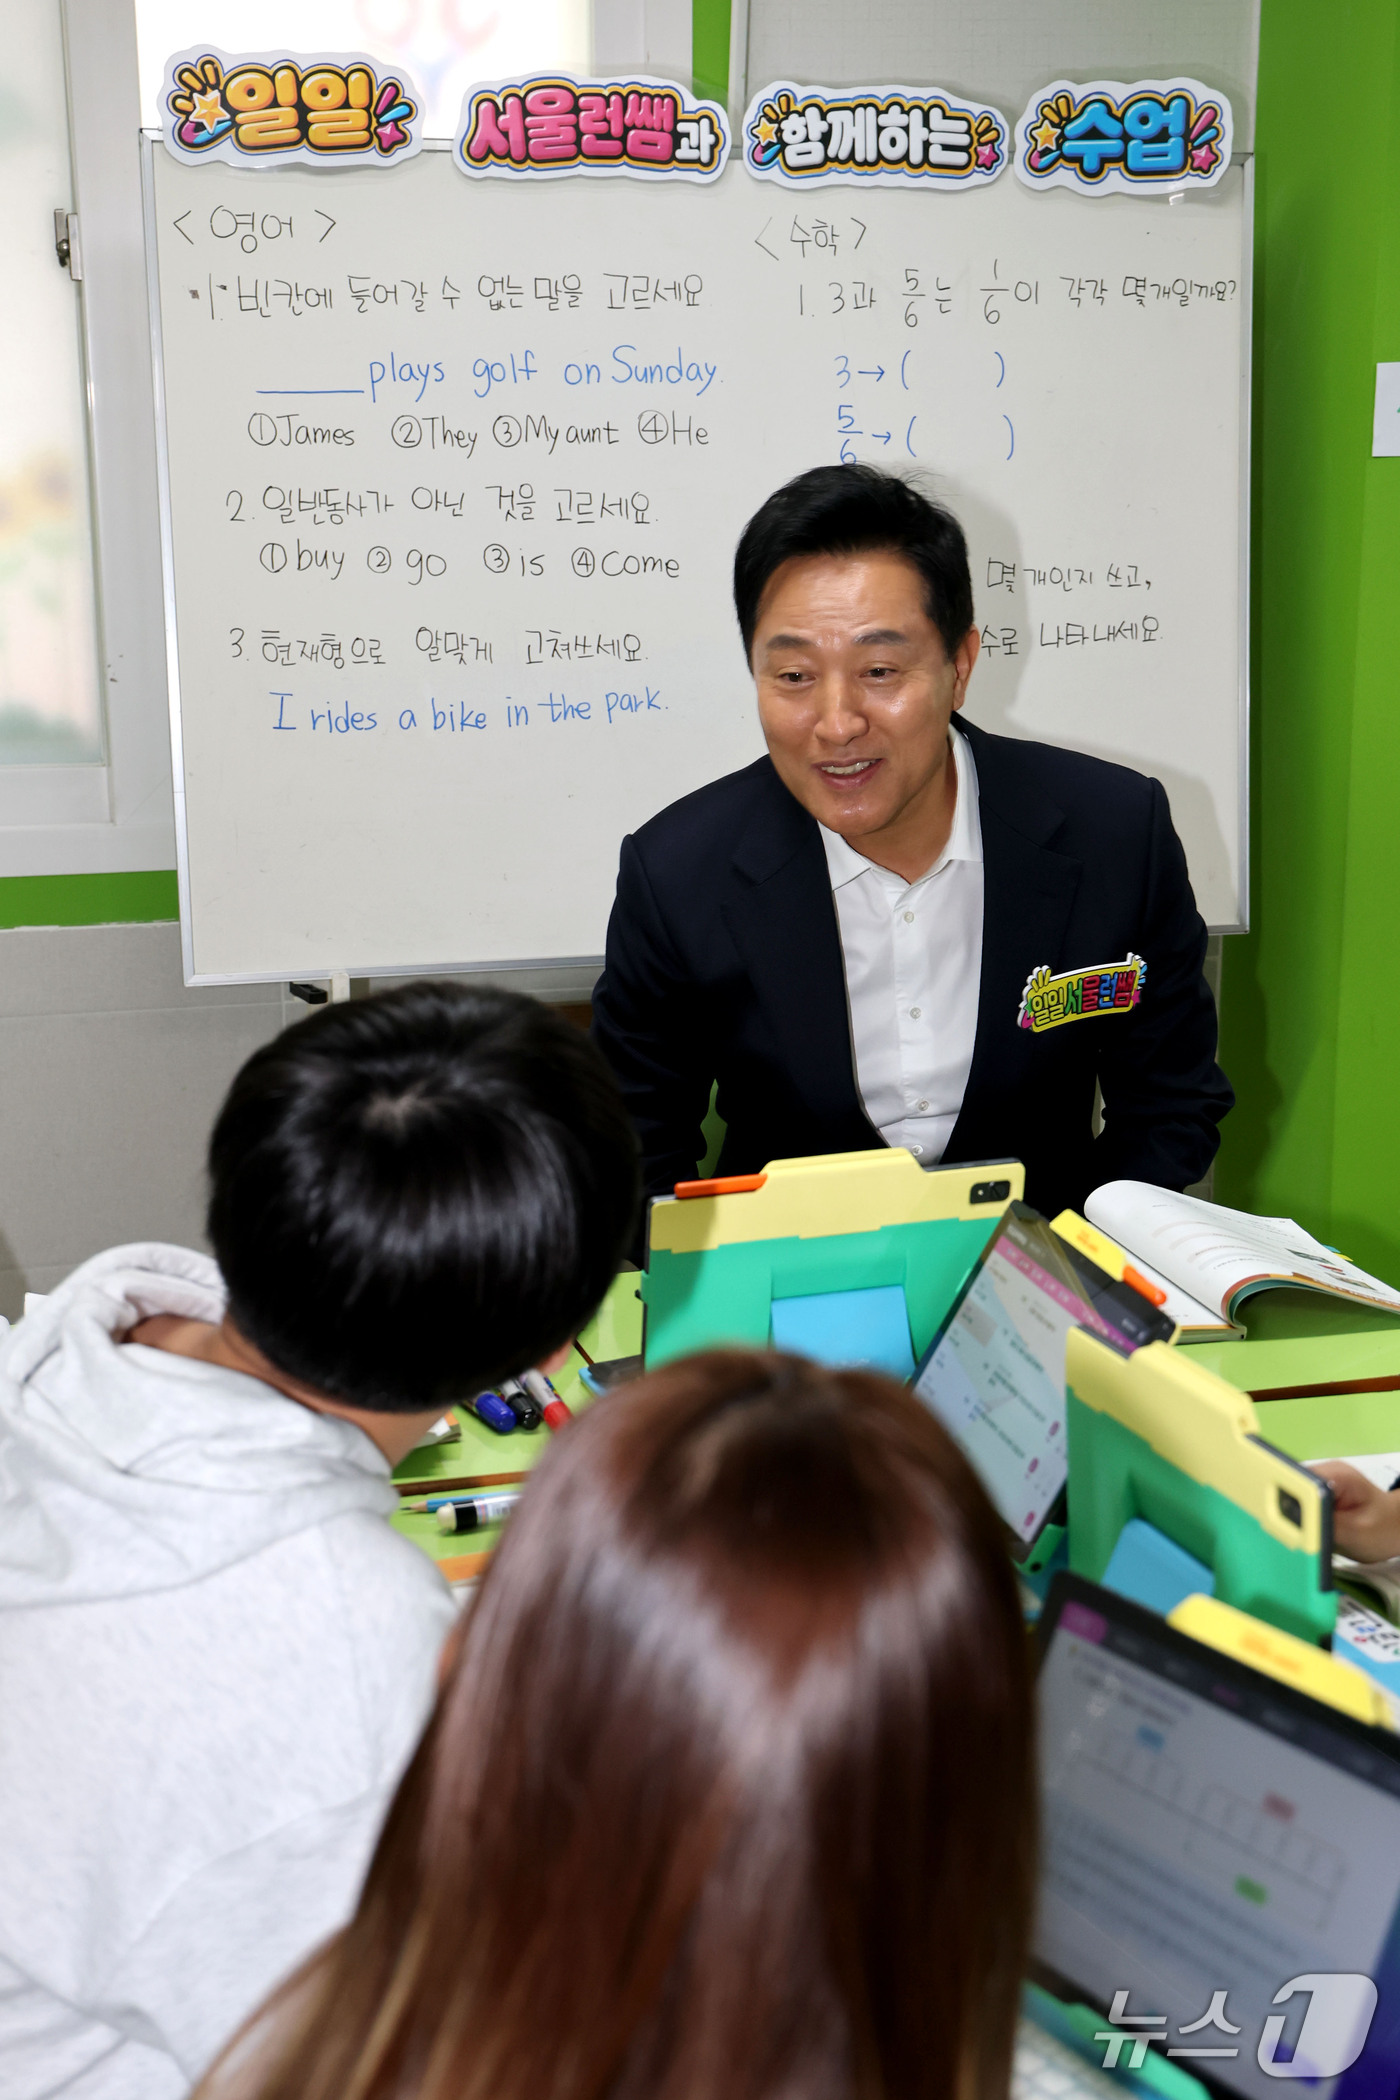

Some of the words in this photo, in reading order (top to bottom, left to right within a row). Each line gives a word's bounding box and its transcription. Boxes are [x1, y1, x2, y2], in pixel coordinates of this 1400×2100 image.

[225, 67, 371, 148] 일일
[469, 83, 717, 165] 서울런쌤과
[779, 104, 972, 166] 함께하는
[1062, 97, 1188, 175] 수업
[237, 275, 333, 319] 빈칸에
[347, 274, 429, 314] 들어갈
[441, 275, 461, 310] 수
[477, 274, 525, 312] 없는
[533, 273, 584, 312] 말을
[1059, 276, 1109, 309] 각각
[369, 351, 446, 404] plays
[472, 349, 538, 399] golf
[563, 363, 601, 386] on
[611, 344, 724, 397] Sunday.
[565, 420, 620, 445] aunt
[225, 489, 255, 522] 2.
[262, 485, 395, 526] 일반동사가
[410, 486, 465, 518] 아닌
[484, 482, 537, 523] 것을
[553, 488, 659, 525] 고르세요.
[229, 627, 250, 662] 3.
[260, 629, 387, 670] 현재형으로
[415, 626, 494, 666] 알맞게
[268, 691, 297, 731] I
[310, 700, 378, 734] rides
[398, 709, 417, 731] a
[431, 697, 488, 733] bike
[505, 696, 529, 728] in
[536, 692, 592, 723] the
[604, 685, 669, 725] park.
